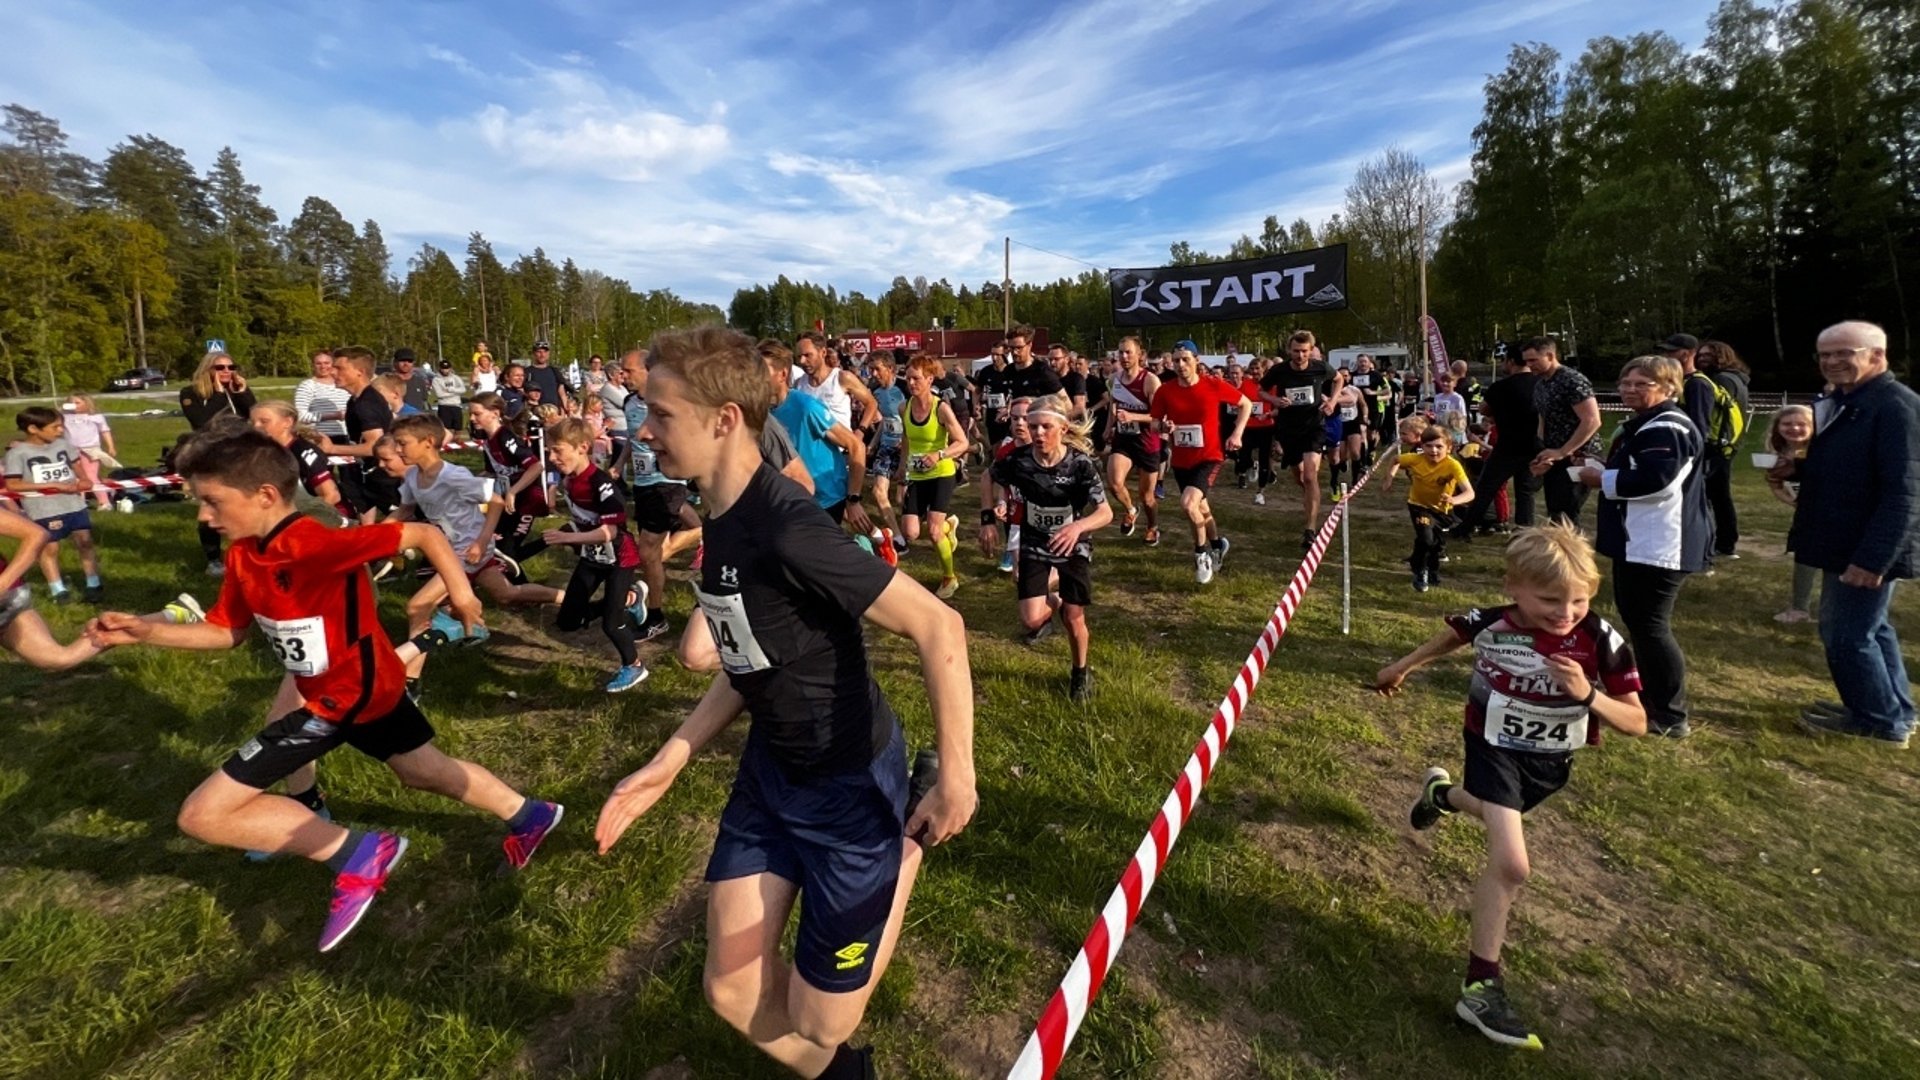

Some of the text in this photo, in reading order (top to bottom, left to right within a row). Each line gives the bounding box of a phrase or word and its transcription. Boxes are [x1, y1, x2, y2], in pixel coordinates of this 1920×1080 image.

[1159, 264, 1315, 311] START
[895, 335, 907, 346] 21
[1181, 432, 1192, 442] 71
[1034, 513, 1064, 527] 388
[1503, 713, 1569, 742] 524
